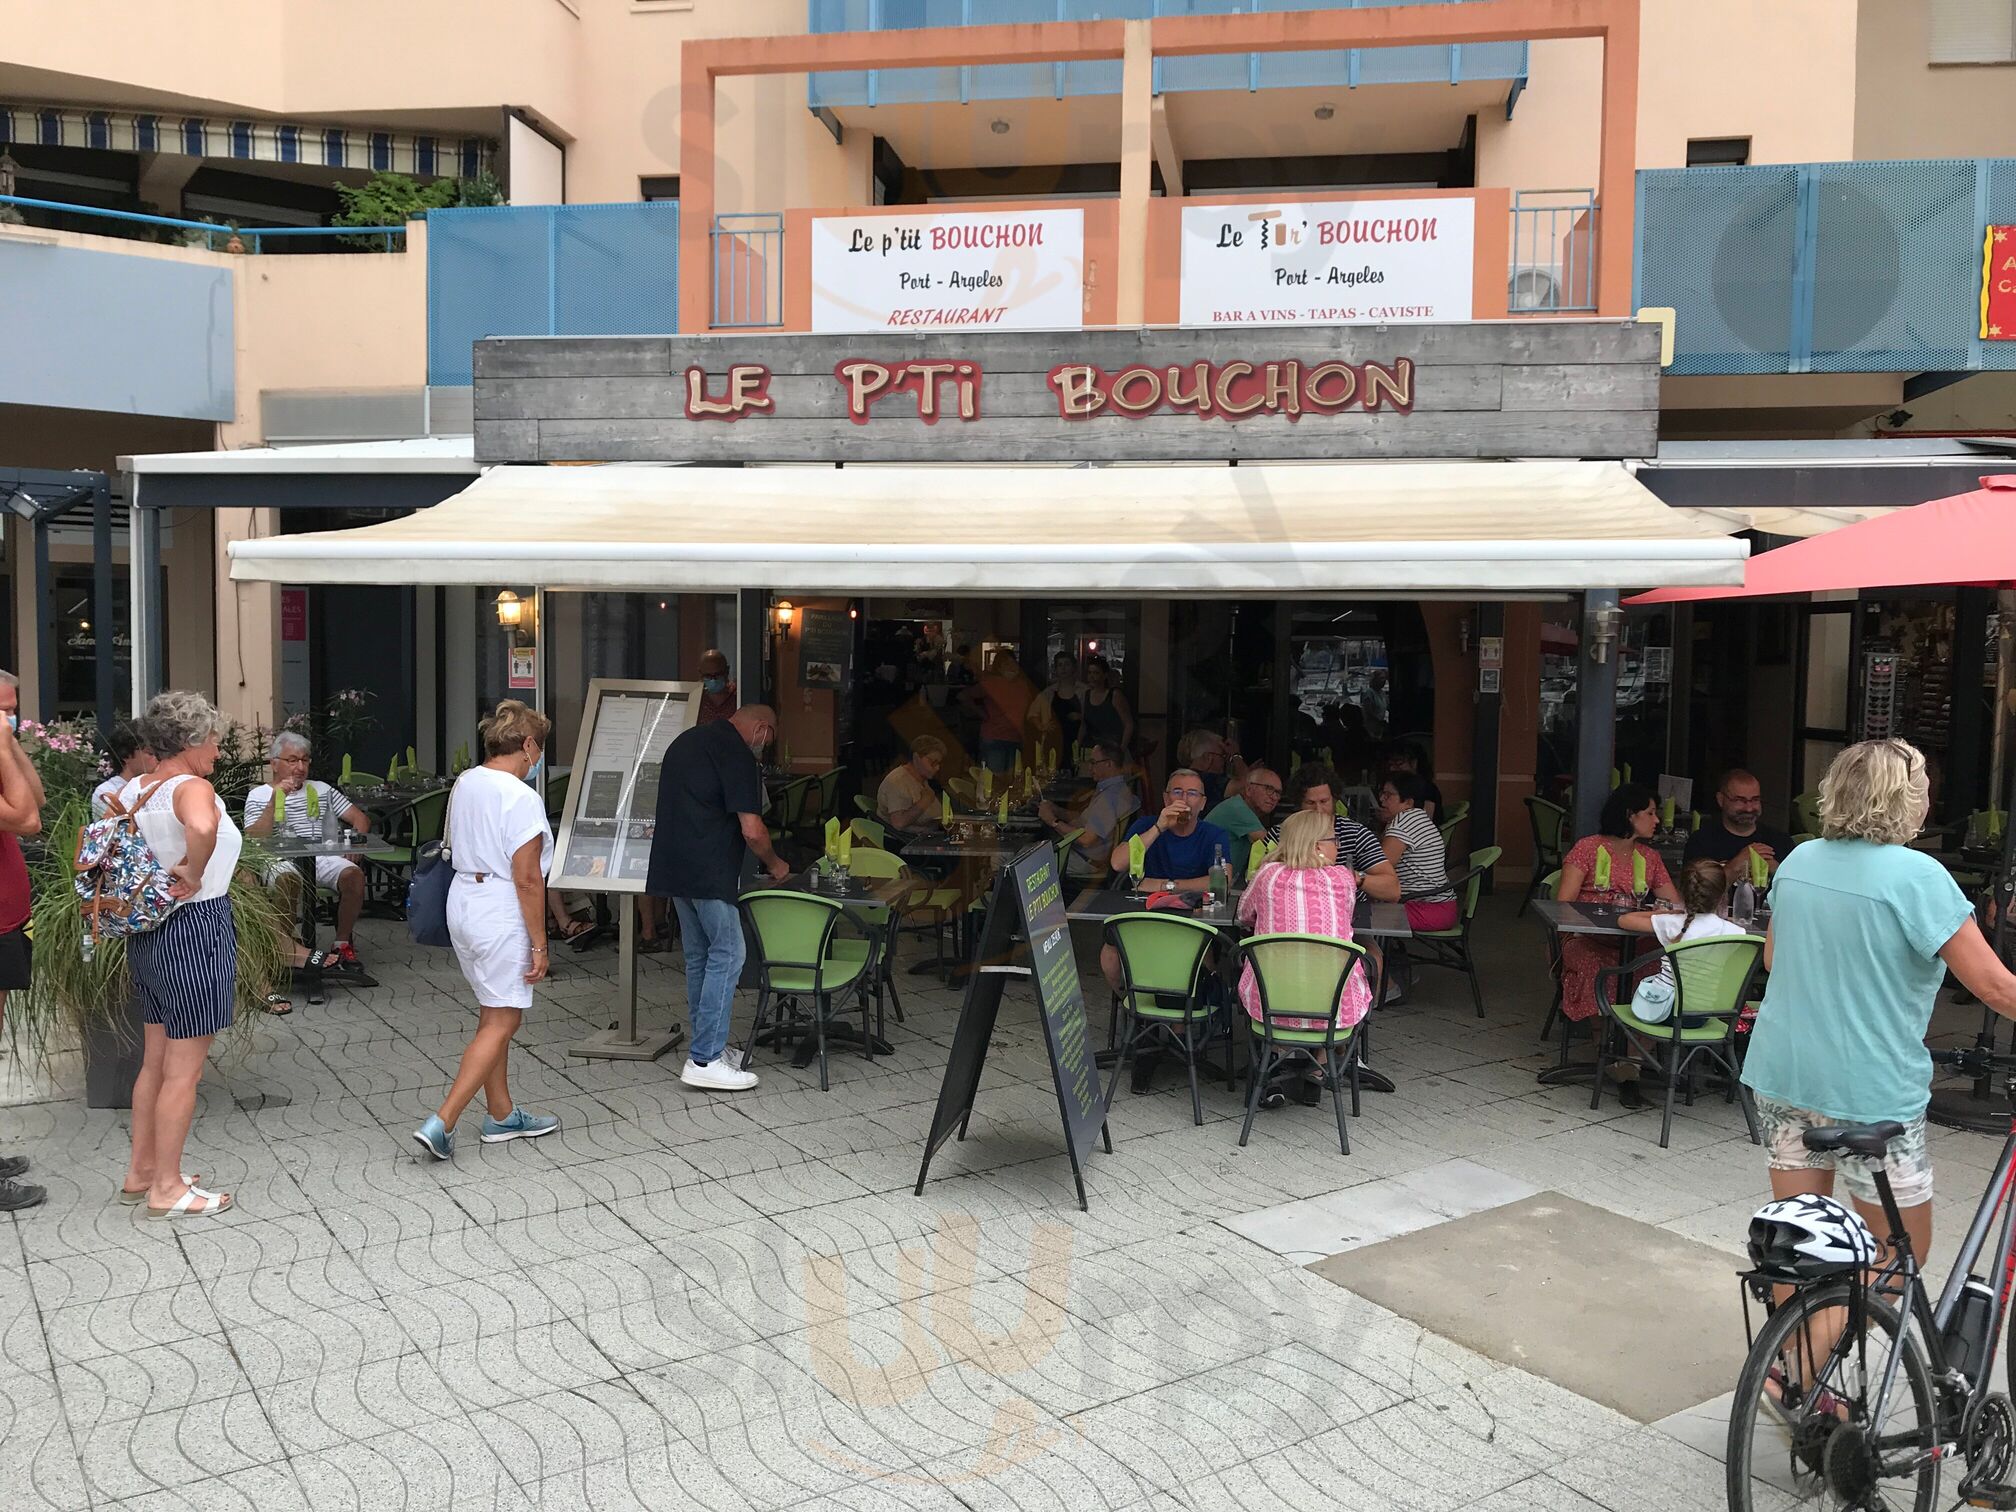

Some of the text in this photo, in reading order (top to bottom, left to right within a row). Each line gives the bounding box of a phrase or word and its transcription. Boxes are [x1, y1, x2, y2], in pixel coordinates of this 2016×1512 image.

[848, 222, 1044, 257] Le p'tit BOUCHON
[1216, 223, 1244, 248] Le
[1317, 216, 1438, 246] BOUCHON
[899, 271, 931, 290] Port
[949, 270, 1003, 292] Argeles
[1275, 267, 1308, 286] Port
[1327, 265, 1385, 288] Argeles
[887, 306, 1008, 326] RESTAURANT
[1213, 310, 1242, 322] BAR
[1246, 310, 1257, 321] A
[1260, 309, 1297, 321] VINS
[1307, 307, 1357, 320] TAPAS
[1368, 306, 1435, 319] CAVISTE
[687, 366, 771, 414] LE
[1052, 358, 1412, 416] BOUCHON
